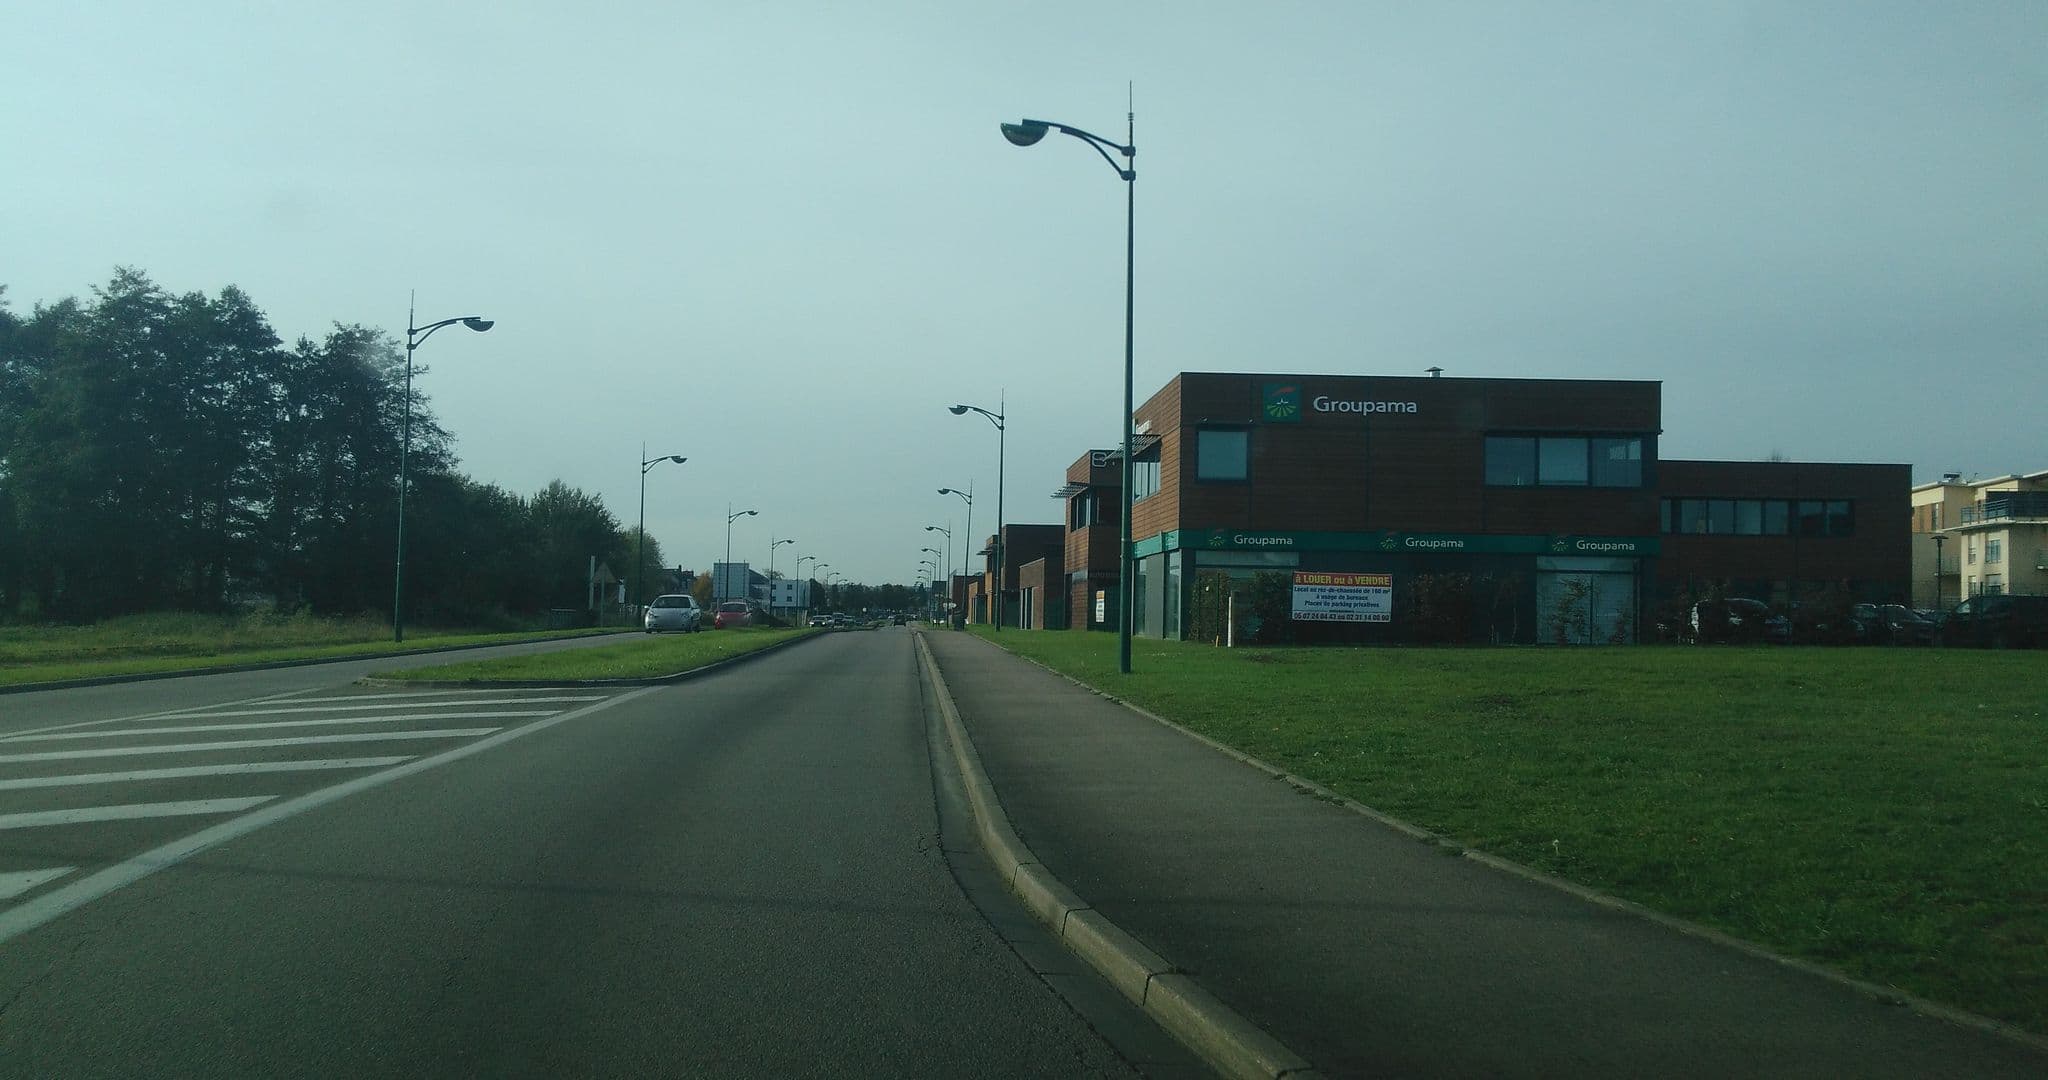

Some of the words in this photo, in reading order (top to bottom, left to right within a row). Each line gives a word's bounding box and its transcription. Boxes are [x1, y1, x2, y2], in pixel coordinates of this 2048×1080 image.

[1313, 395, 1417, 416] Groupama
[1234, 534, 1293, 547] Groupama
[1405, 537, 1464, 549] Groupama
[1576, 540, 1635, 552] Groupama
[1303, 575, 1332, 584] LOUER
[1334, 576, 1345, 584] ou
[1354, 575, 1390, 585] VENDRE
